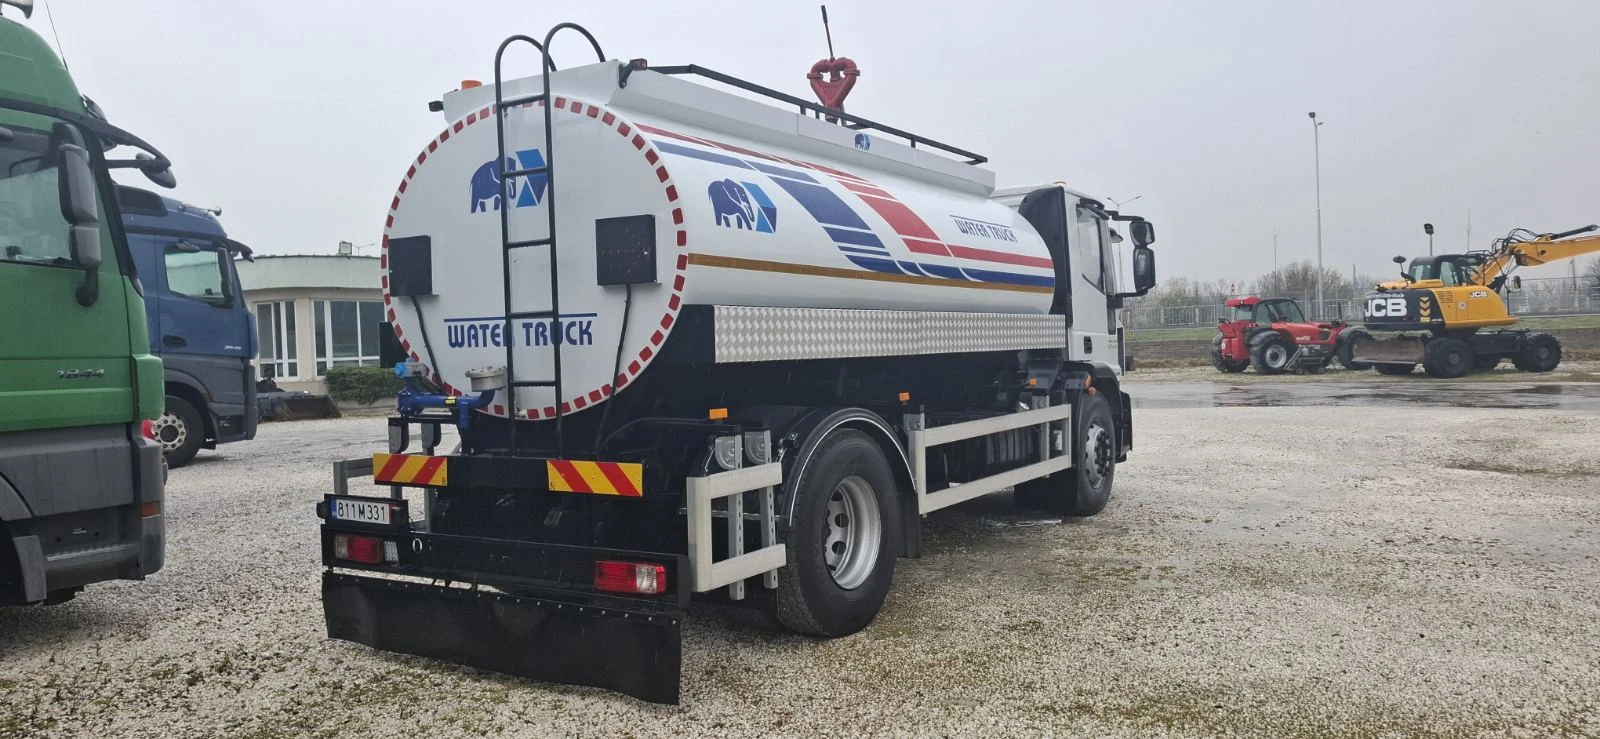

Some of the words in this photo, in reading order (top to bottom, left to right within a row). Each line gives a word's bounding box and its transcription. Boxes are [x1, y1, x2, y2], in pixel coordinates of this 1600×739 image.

[952, 218, 991, 239] WATER
[985, 224, 1018, 243] TRUCK
[1364, 298, 1408, 317] JCB
[522, 320, 593, 347] TRUCK
[338, 502, 386, 521] 811M331
